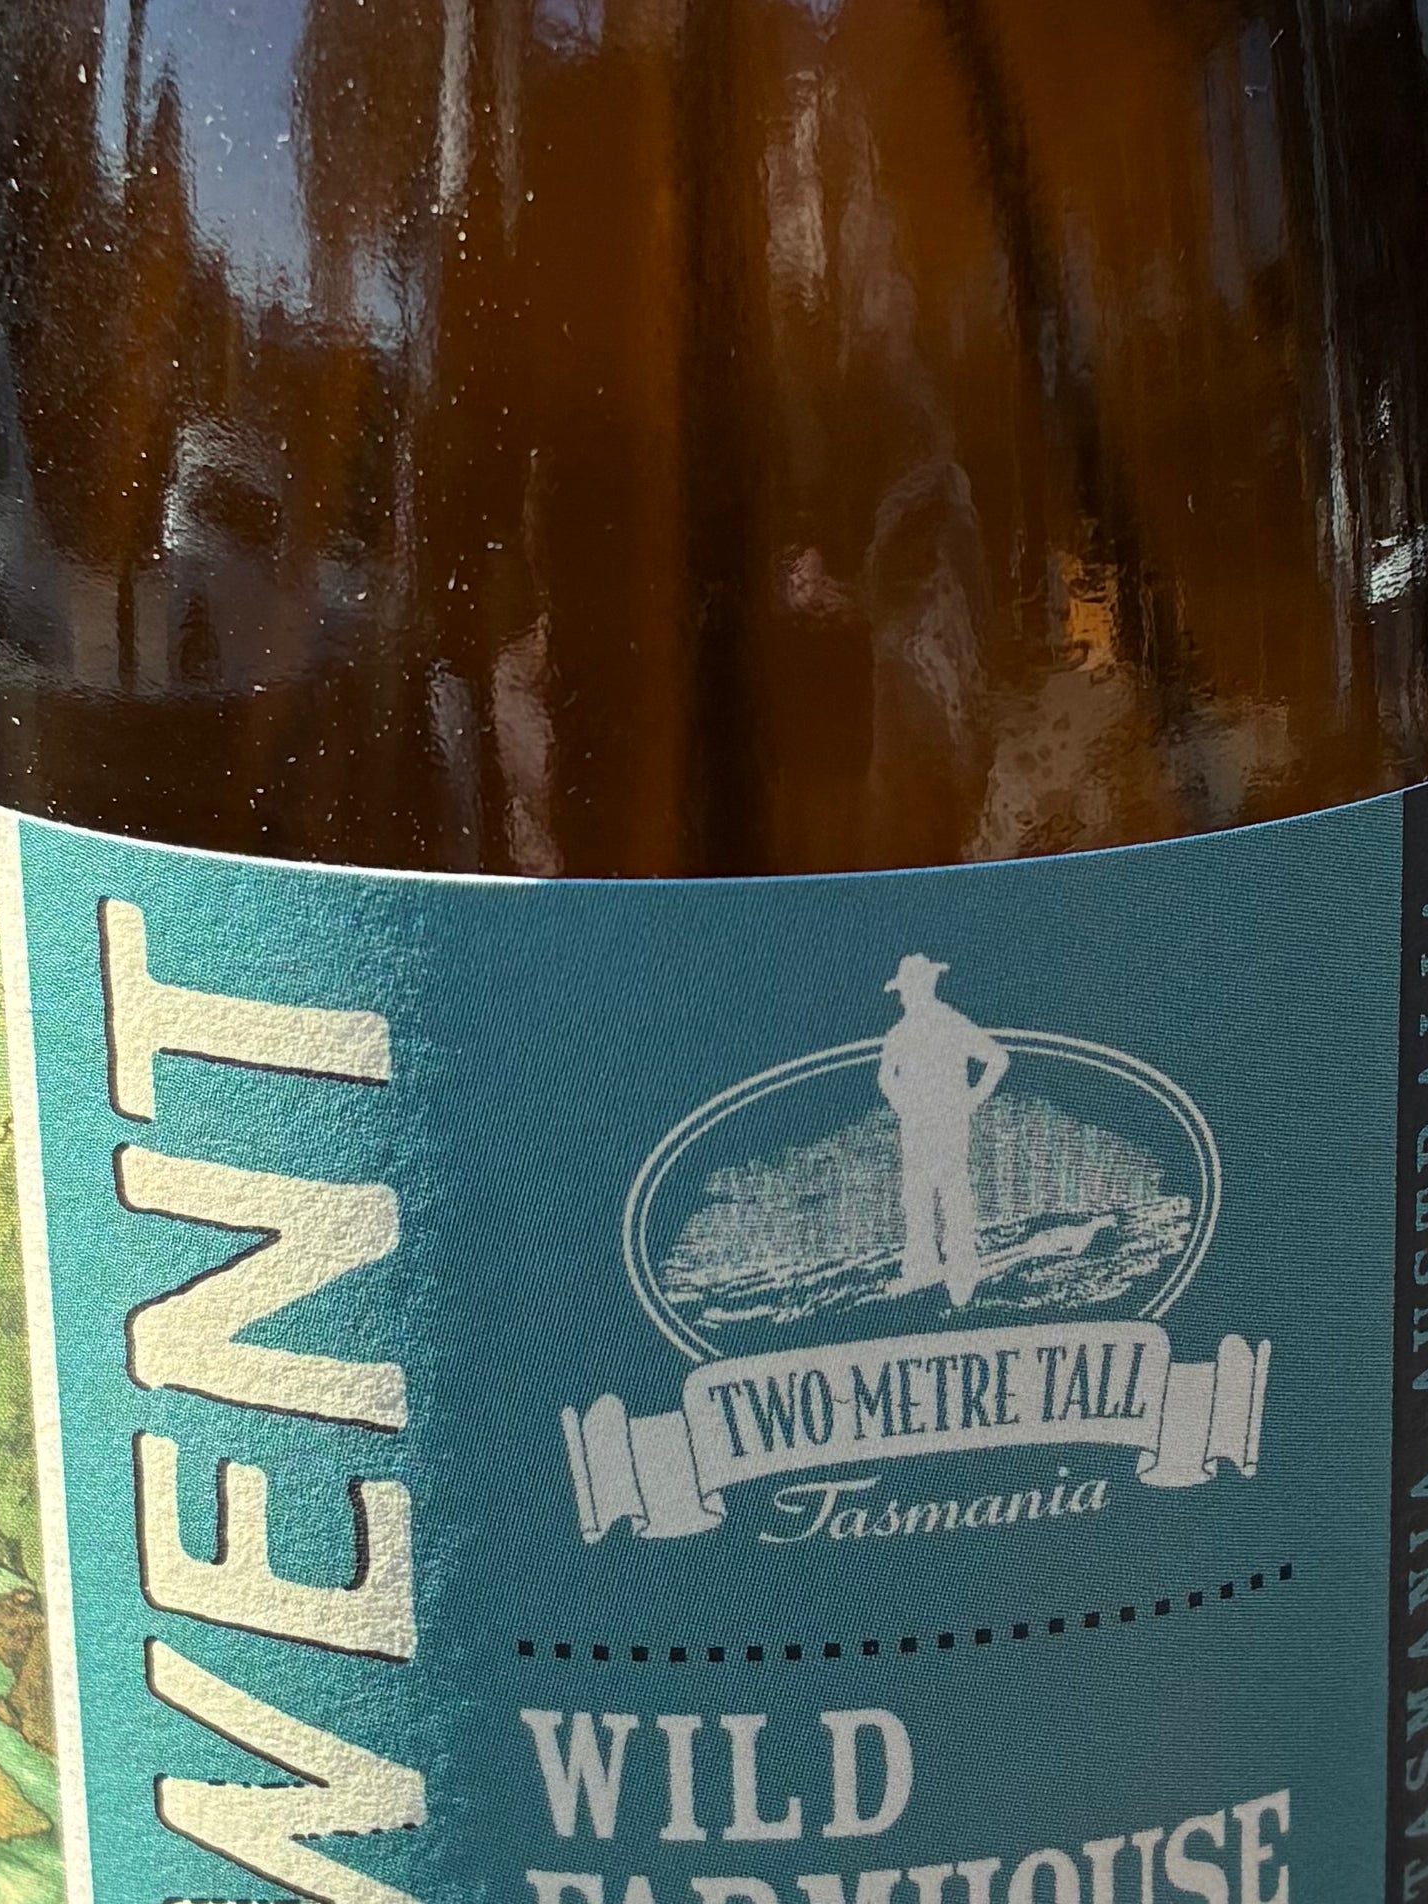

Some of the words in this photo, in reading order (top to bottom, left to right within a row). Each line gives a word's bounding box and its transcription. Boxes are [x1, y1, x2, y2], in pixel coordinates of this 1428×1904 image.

[708, 1368, 835, 1459] TWO
[850, 1348, 1020, 1442] METRE
[1036, 1342, 1148, 1423] TALL
[759, 1466, 1110, 1544] Tasmania
[520, 1707, 915, 1842] WILD
